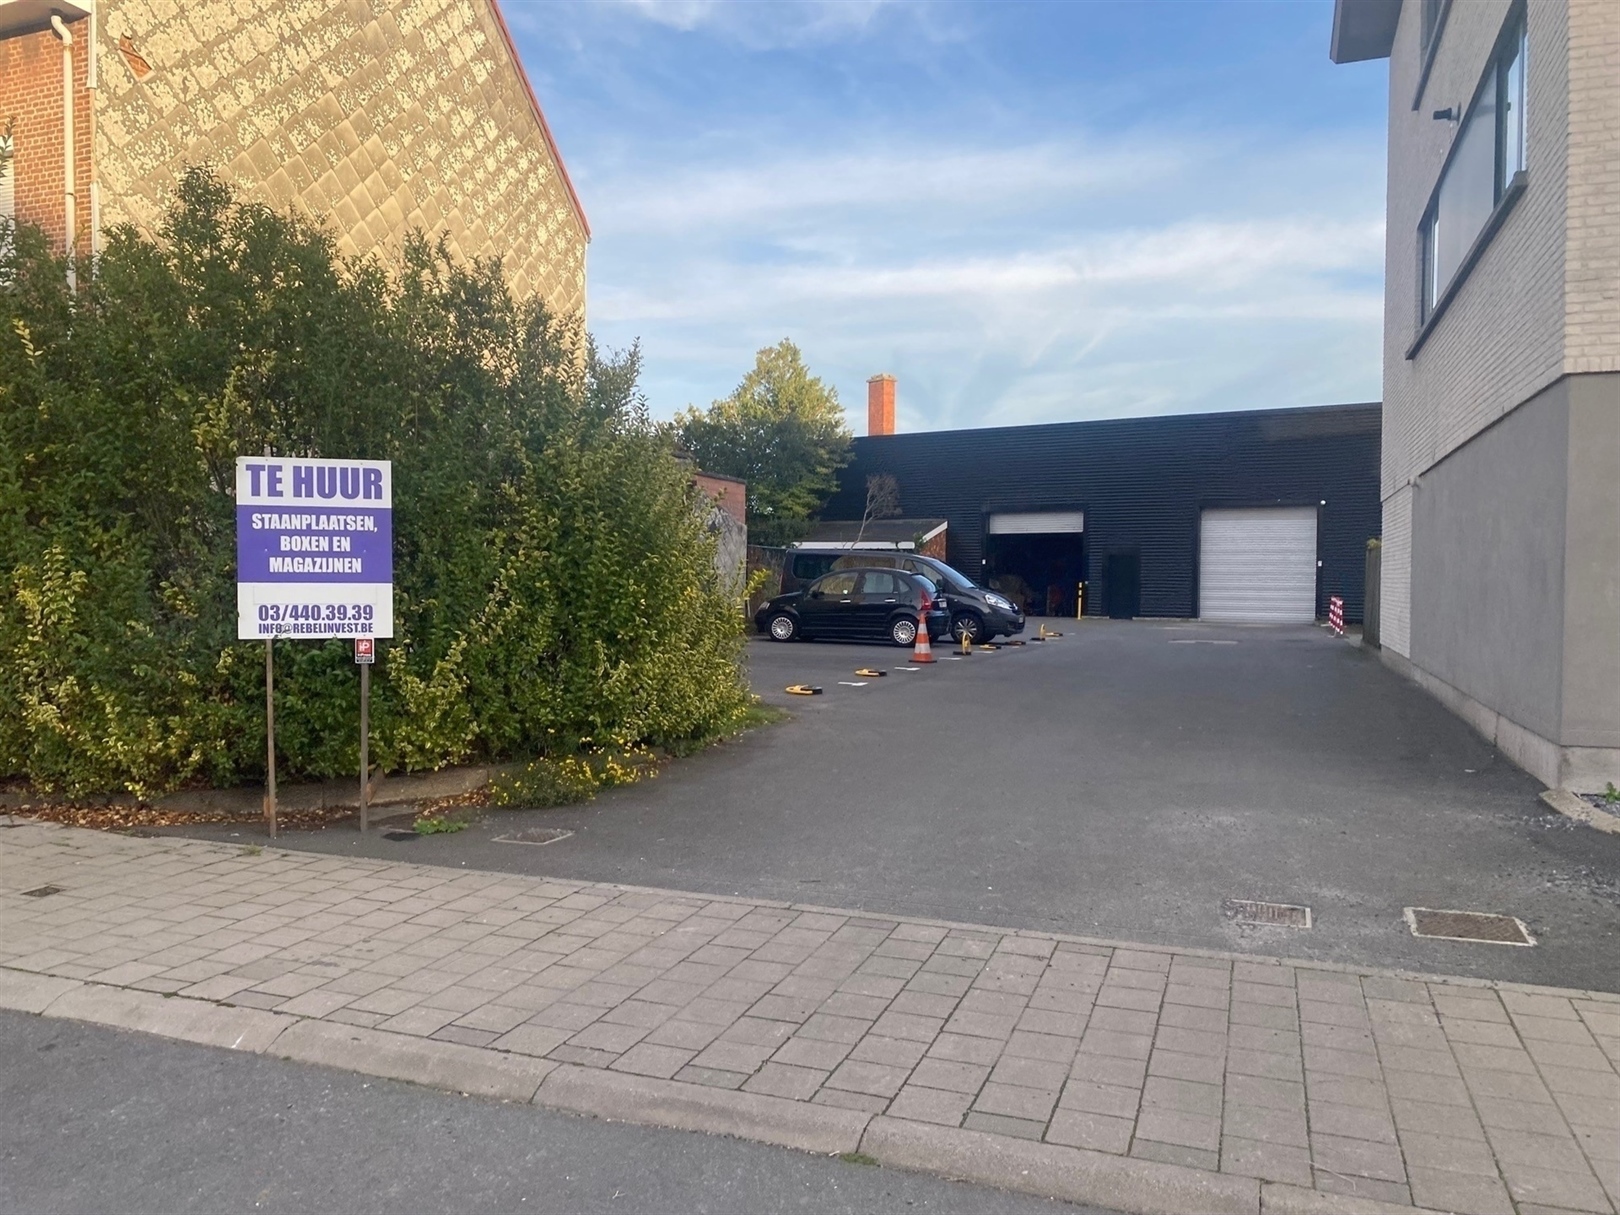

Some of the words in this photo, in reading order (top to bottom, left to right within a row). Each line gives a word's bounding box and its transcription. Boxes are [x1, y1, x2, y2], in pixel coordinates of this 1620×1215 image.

[245, 464, 284, 498] TE
[292, 466, 383, 500] HUUR
[251, 513, 378, 533] STAANPLAATSEN,
[280, 535, 329, 552] BOXEN
[332, 536, 351, 552] EN
[269, 557, 362, 574] MAGAZIJNEN
[258, 604, 374, 622] 03/440.39.39
[258, 622, 374, 634] INFO@REBELINVEST.BE
